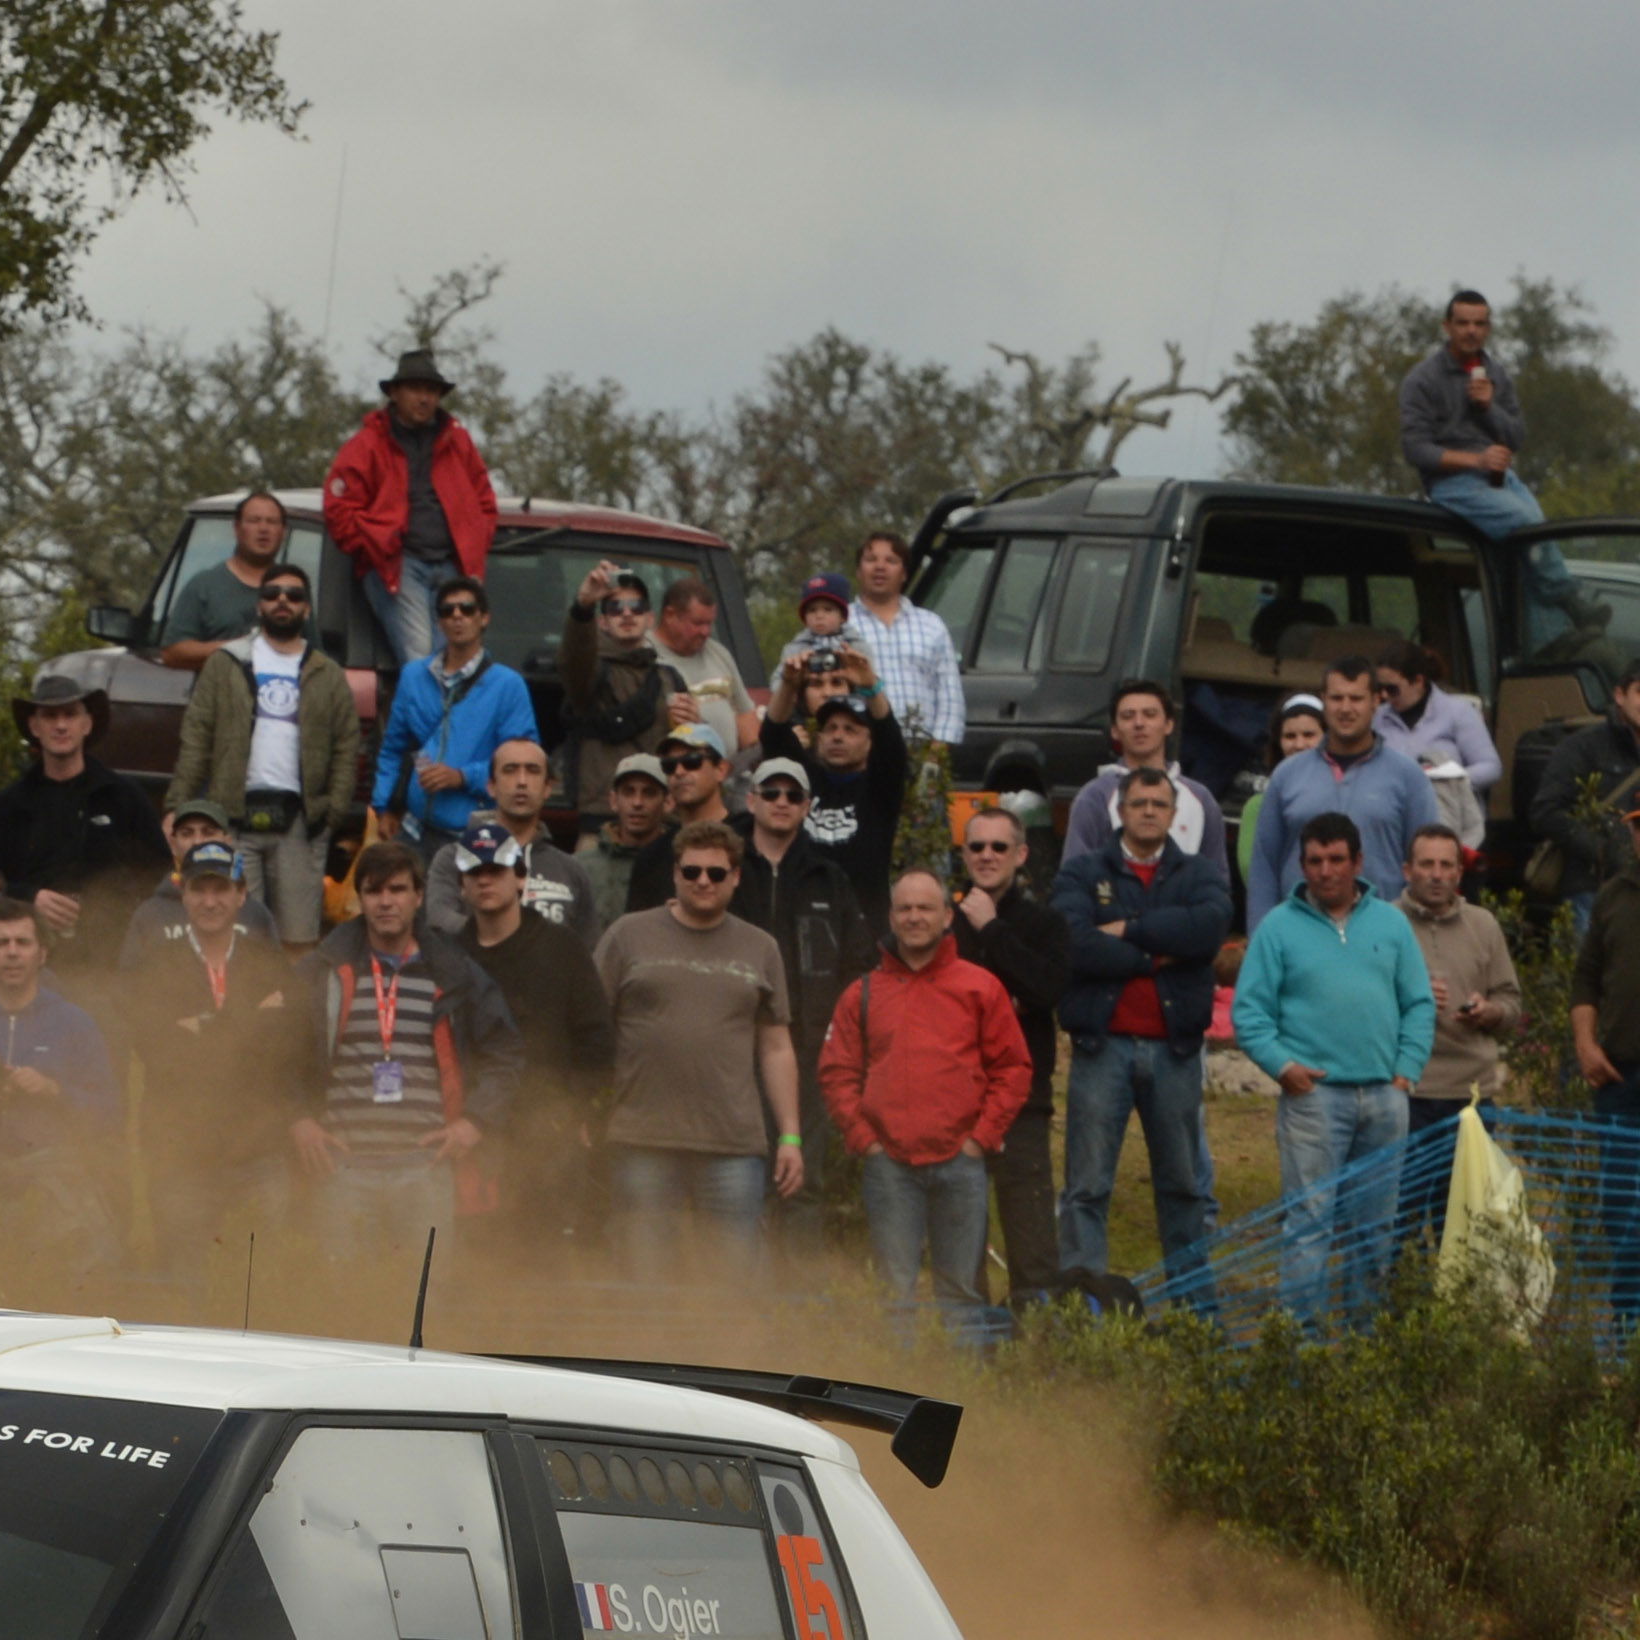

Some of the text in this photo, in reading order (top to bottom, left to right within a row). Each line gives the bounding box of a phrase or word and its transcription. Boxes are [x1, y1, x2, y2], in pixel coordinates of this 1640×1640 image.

[22, 1428, 96, 1454] FOR
[101, 1441, 173, 1471] LIFE
[609, 1583, 641, 1633] S.
